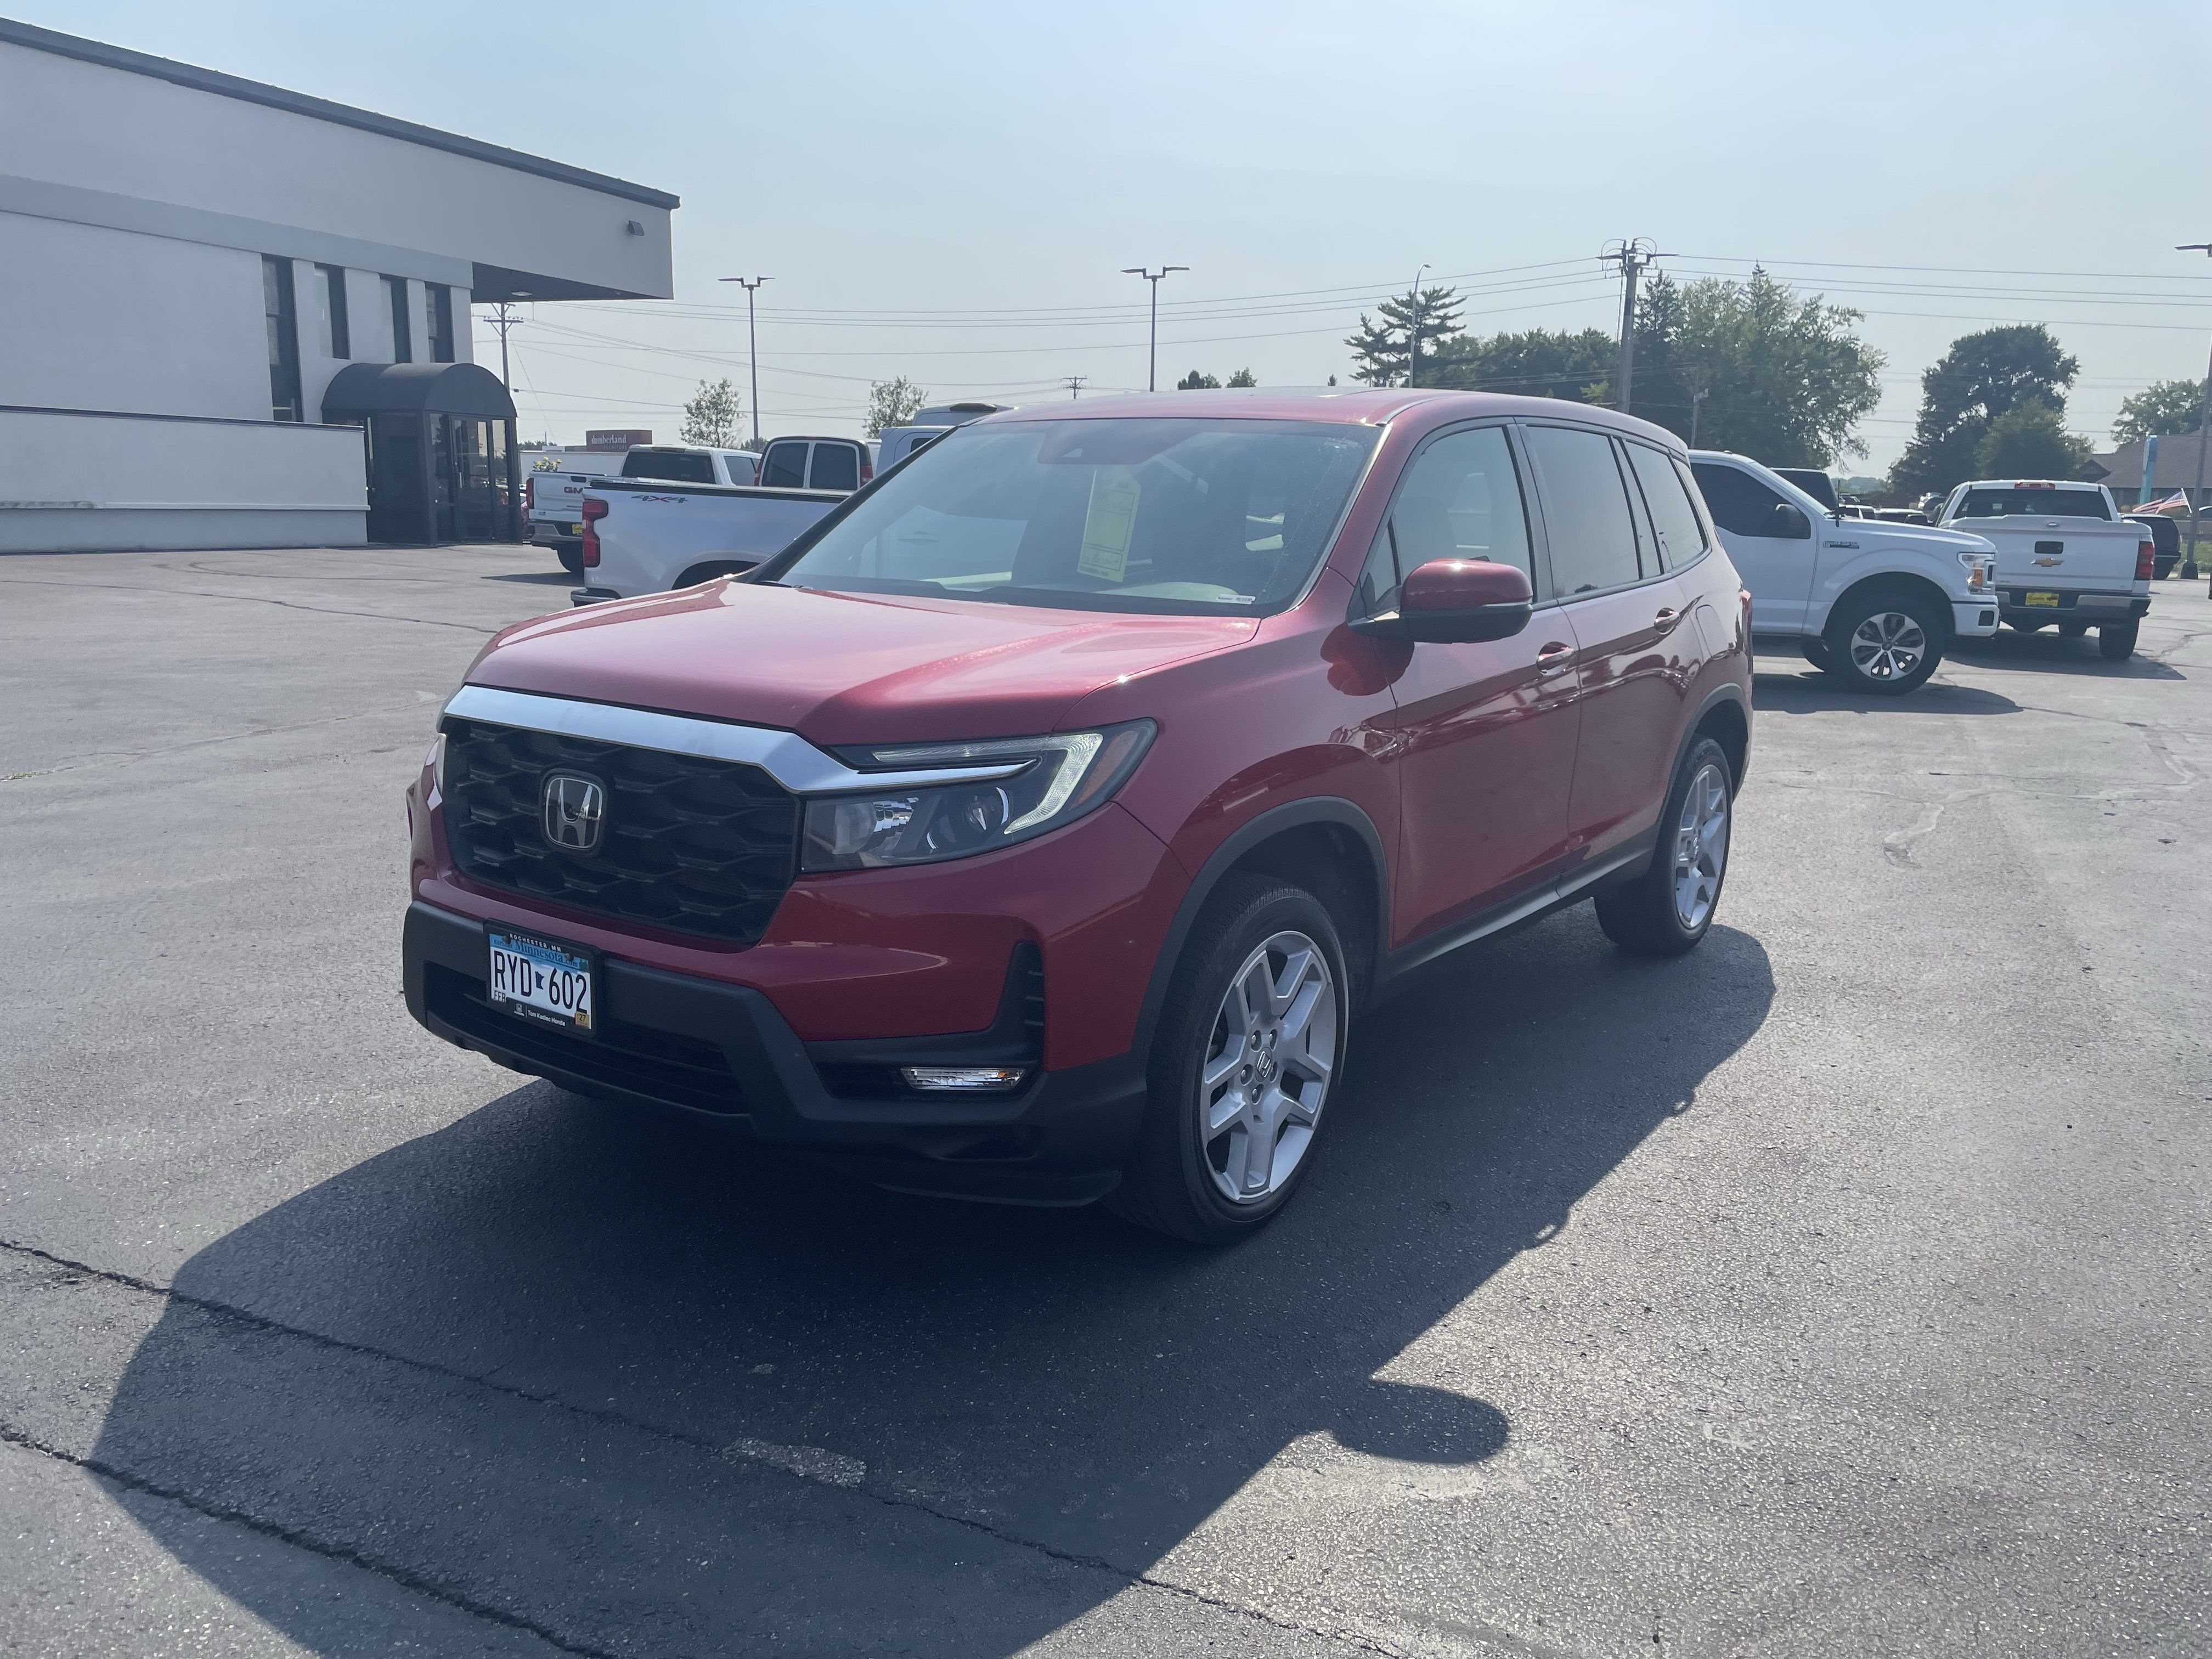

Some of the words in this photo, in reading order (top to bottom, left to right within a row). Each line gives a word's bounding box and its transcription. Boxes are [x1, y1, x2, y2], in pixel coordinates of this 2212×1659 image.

[494, 950, 532, 997] RYD
[549, 968, 587, 1014] 602
[551, 1017, 566, 1026] Honda
